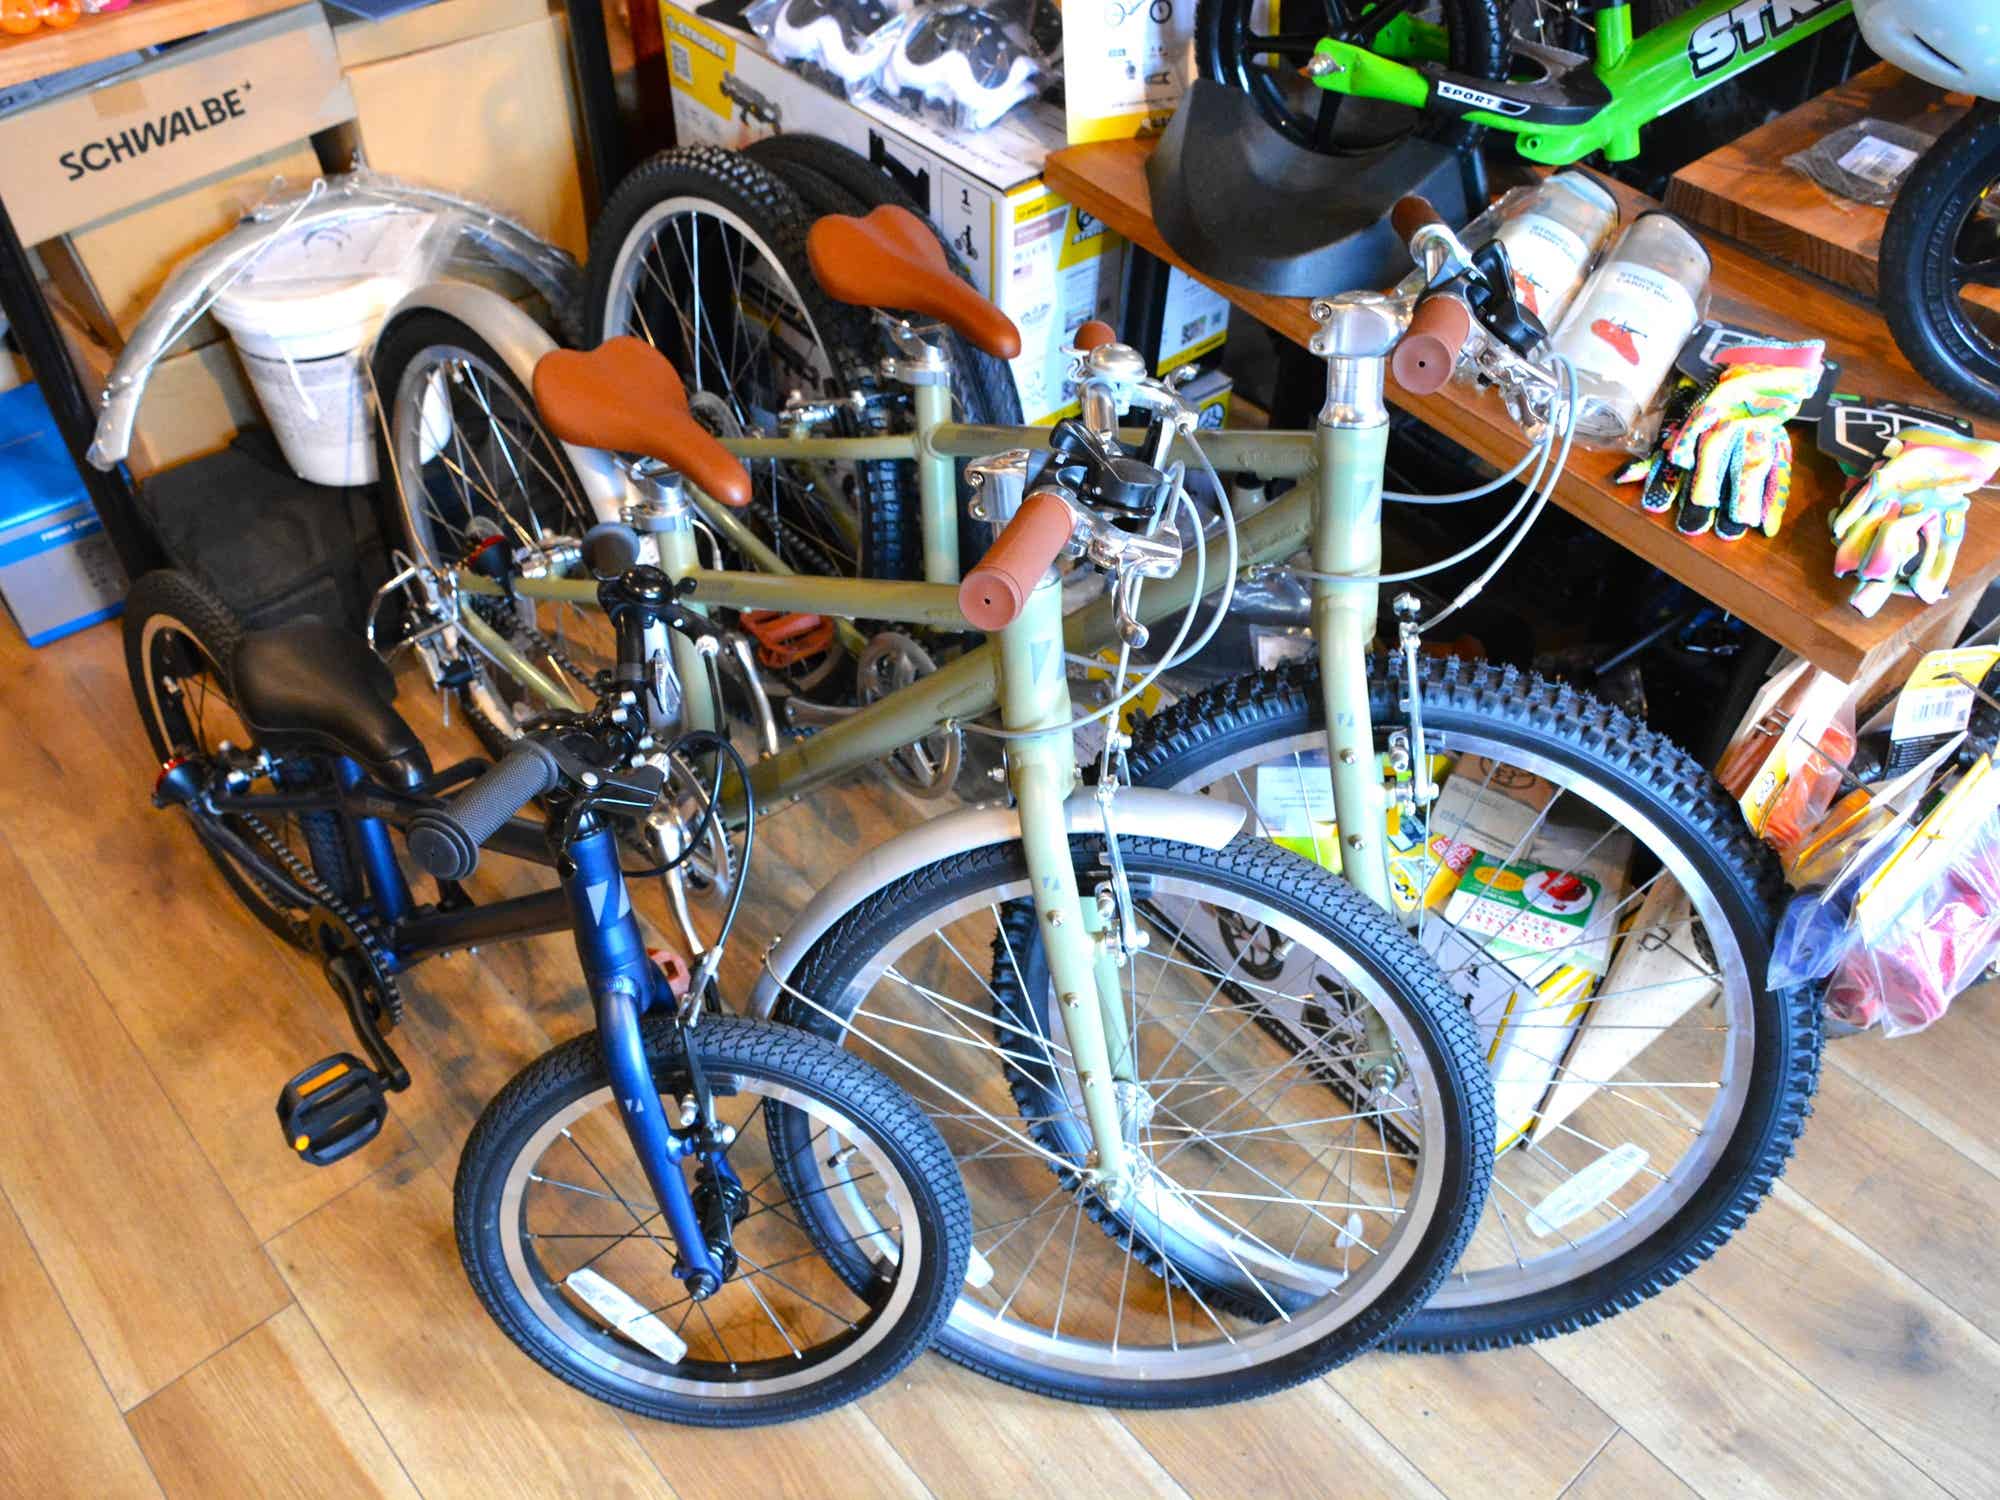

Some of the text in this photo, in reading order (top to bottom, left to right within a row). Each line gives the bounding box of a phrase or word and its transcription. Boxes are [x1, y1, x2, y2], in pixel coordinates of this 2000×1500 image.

[1442, 86, 1495, 106] SPORT
[59, 89, 246, 181] SCHWALBE
[961, 189, 971, 206] 1
